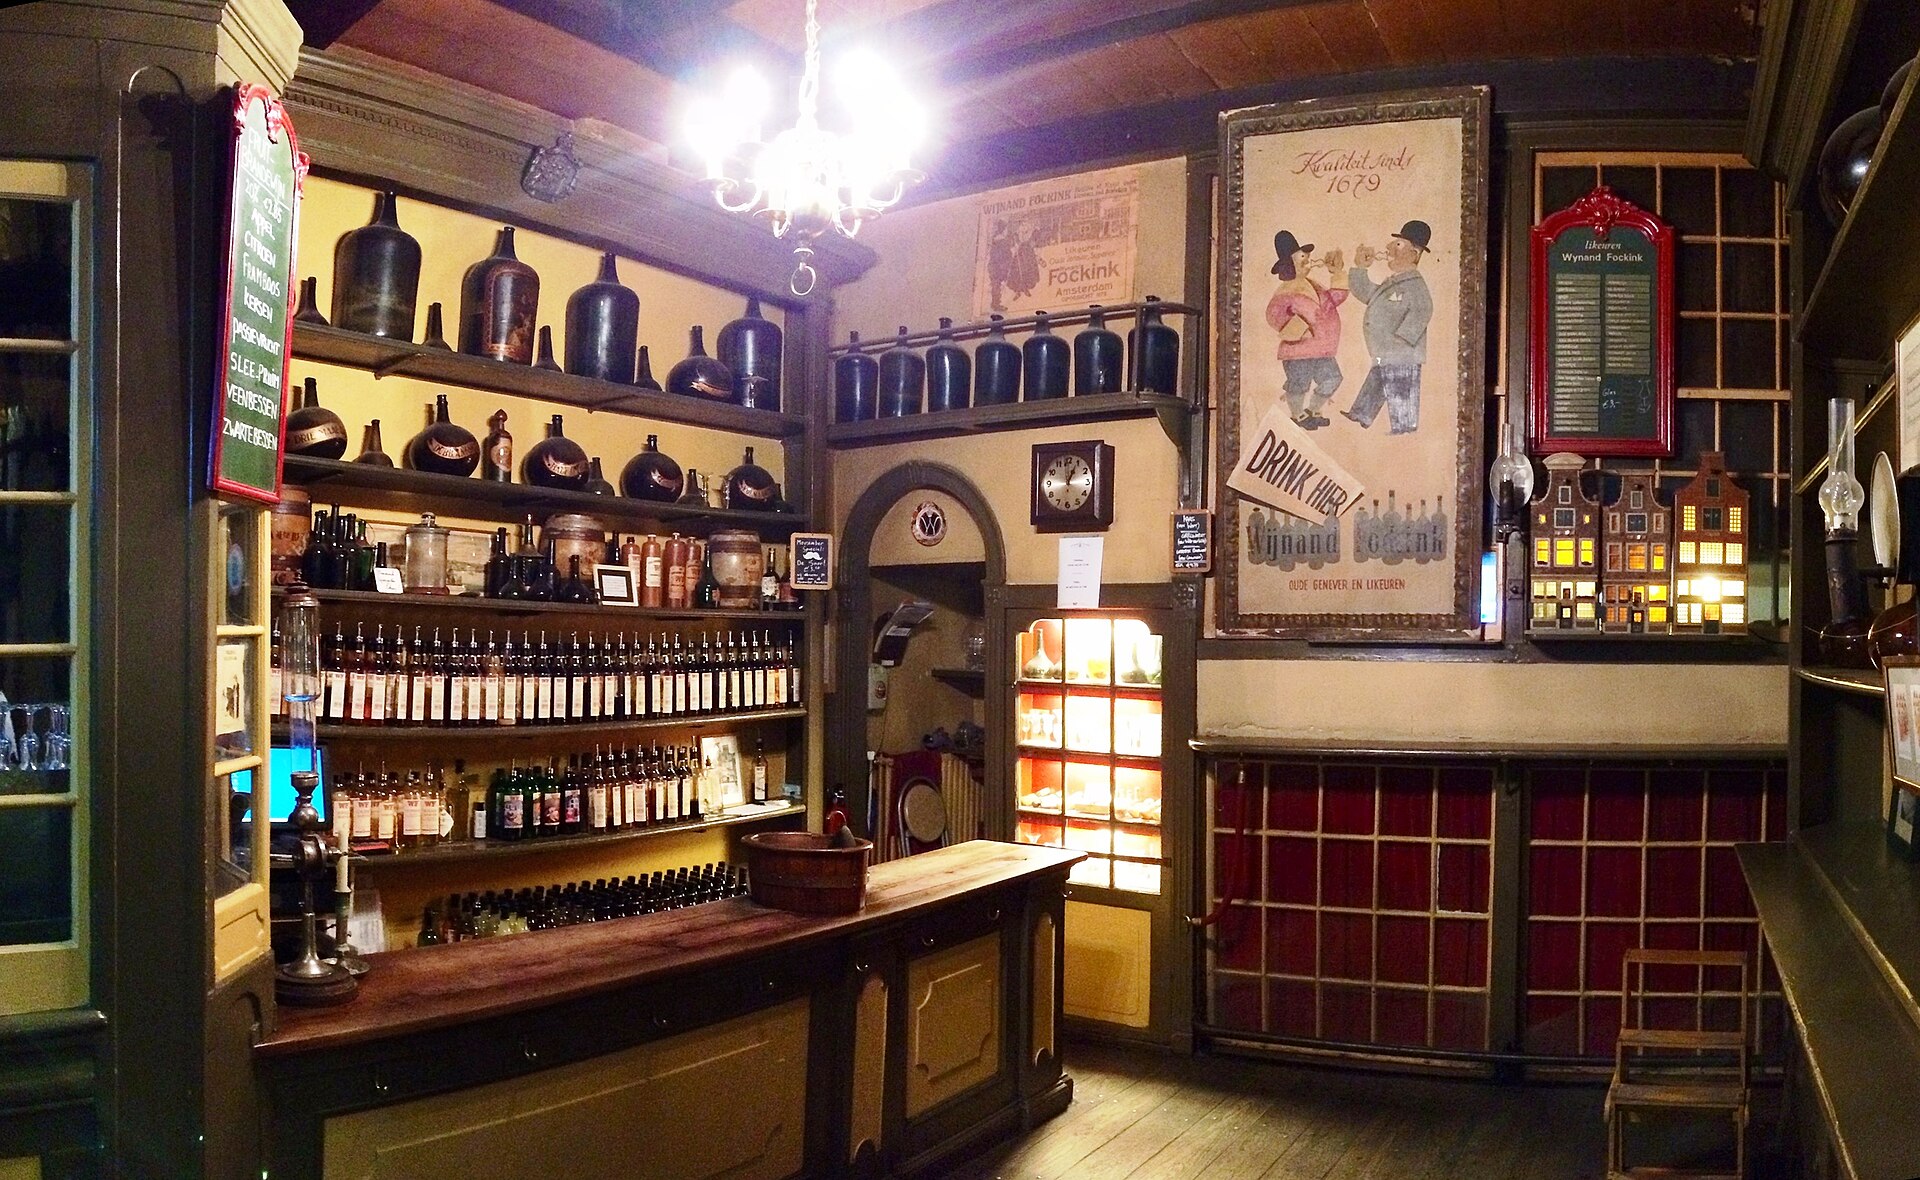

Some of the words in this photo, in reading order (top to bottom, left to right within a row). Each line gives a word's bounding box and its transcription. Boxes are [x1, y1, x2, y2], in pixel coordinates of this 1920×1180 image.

[1327, 174, 1380, 199] 1679
[251, 208, 275, 240] APPEL
[244, 230, 276, 268] CITROEN
[1562, 253, 1601, 263] Wynand
[1606, 253, 1643, 262] Fockink
[1585, 240, 1622, 250] likeuren
[243, 252, 280, 297] FRAMBOOS
[1048, 261, 1120, 286] Fockink
[244, 286, 273, 323] KERSEN
[1056, 282, 1113, 298] Amsterdam
[226, 382, 278, 420] VEENBESSEN
[1245, 429, 1319, 501] DRINK
[1246, 526, 1338, 561] Wijnand
[1355, 524, 1444, 553] ocink
[1289, 579, 1308, 591] OUDE
[1313, 579, 1347, 590] GENEVER
[1352, 579, 1363, 590] EN
[1366, 578, 1405, 590] LIKEUREN
